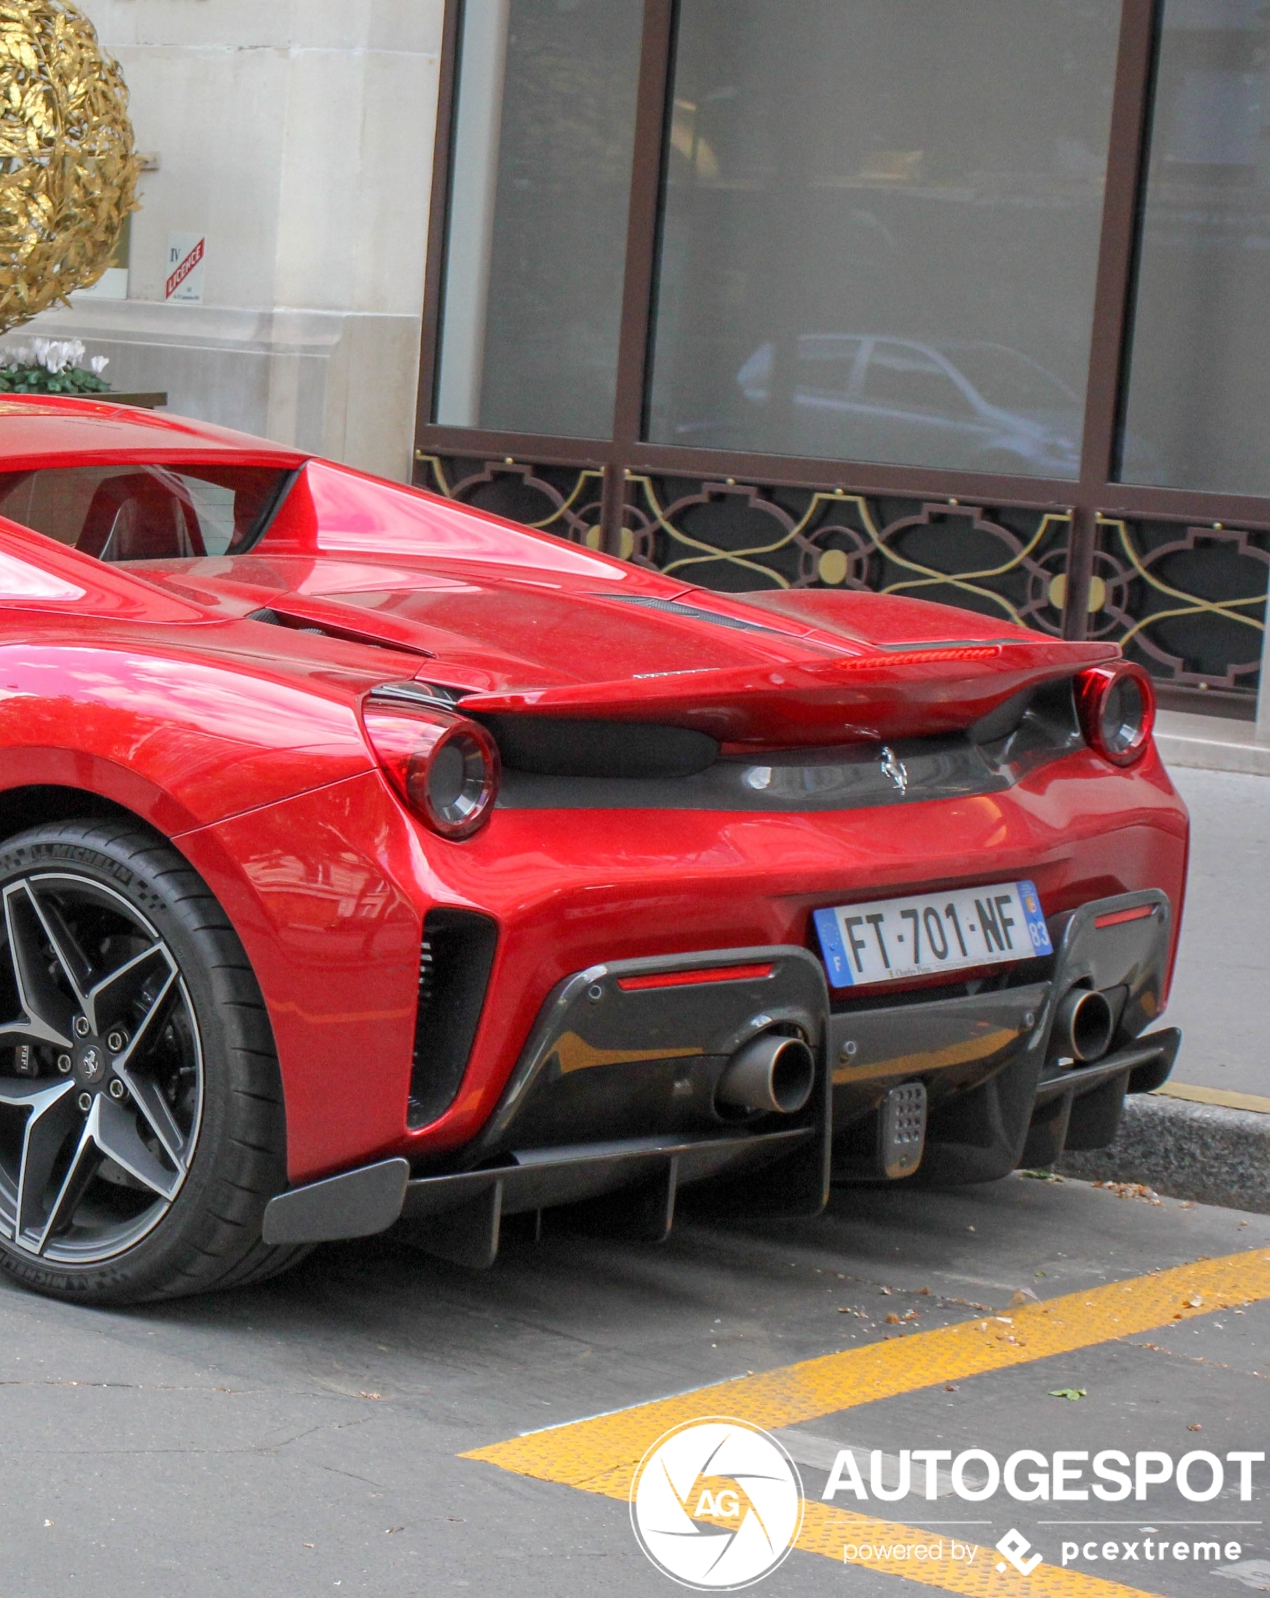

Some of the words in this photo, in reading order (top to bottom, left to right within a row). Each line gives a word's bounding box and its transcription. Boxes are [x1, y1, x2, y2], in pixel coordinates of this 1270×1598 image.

[170, 248, 180, 262] IV
[168, 245, 202, 293] LICENCE
[50, 844, 133, 883] MICHELIN
[1029, 921, 1049, 946] 83
[833, 956, 842, 972] F
